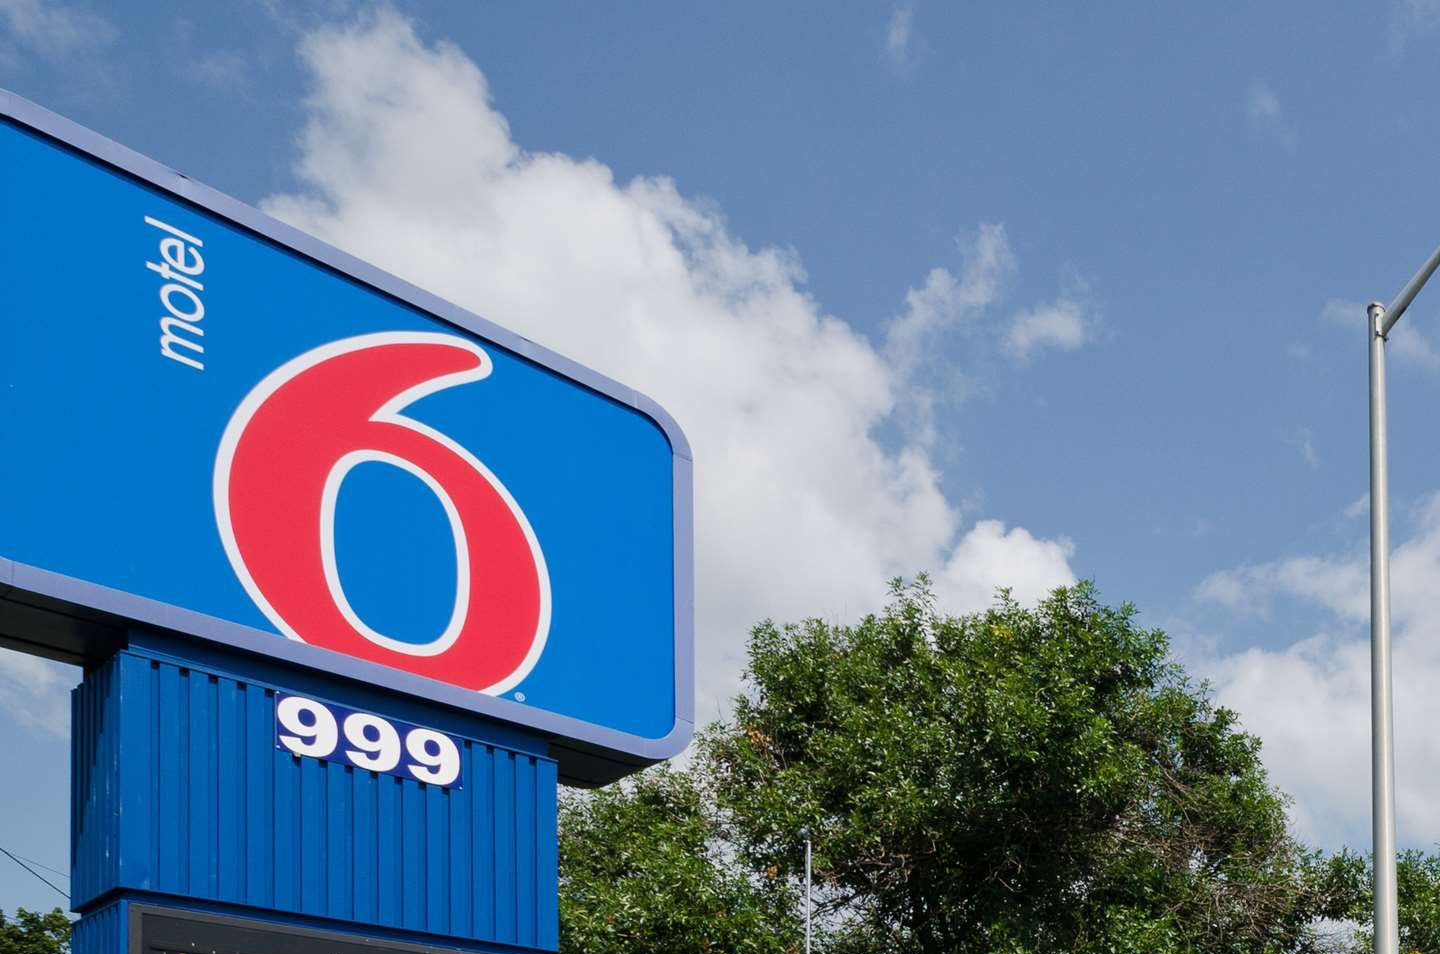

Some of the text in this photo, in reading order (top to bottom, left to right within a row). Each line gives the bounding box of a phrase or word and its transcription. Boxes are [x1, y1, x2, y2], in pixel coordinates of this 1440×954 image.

[144, 216, 205, 370] motel
[213, 331, 552, 697] 6
[278, 697, 461, 786] 999
